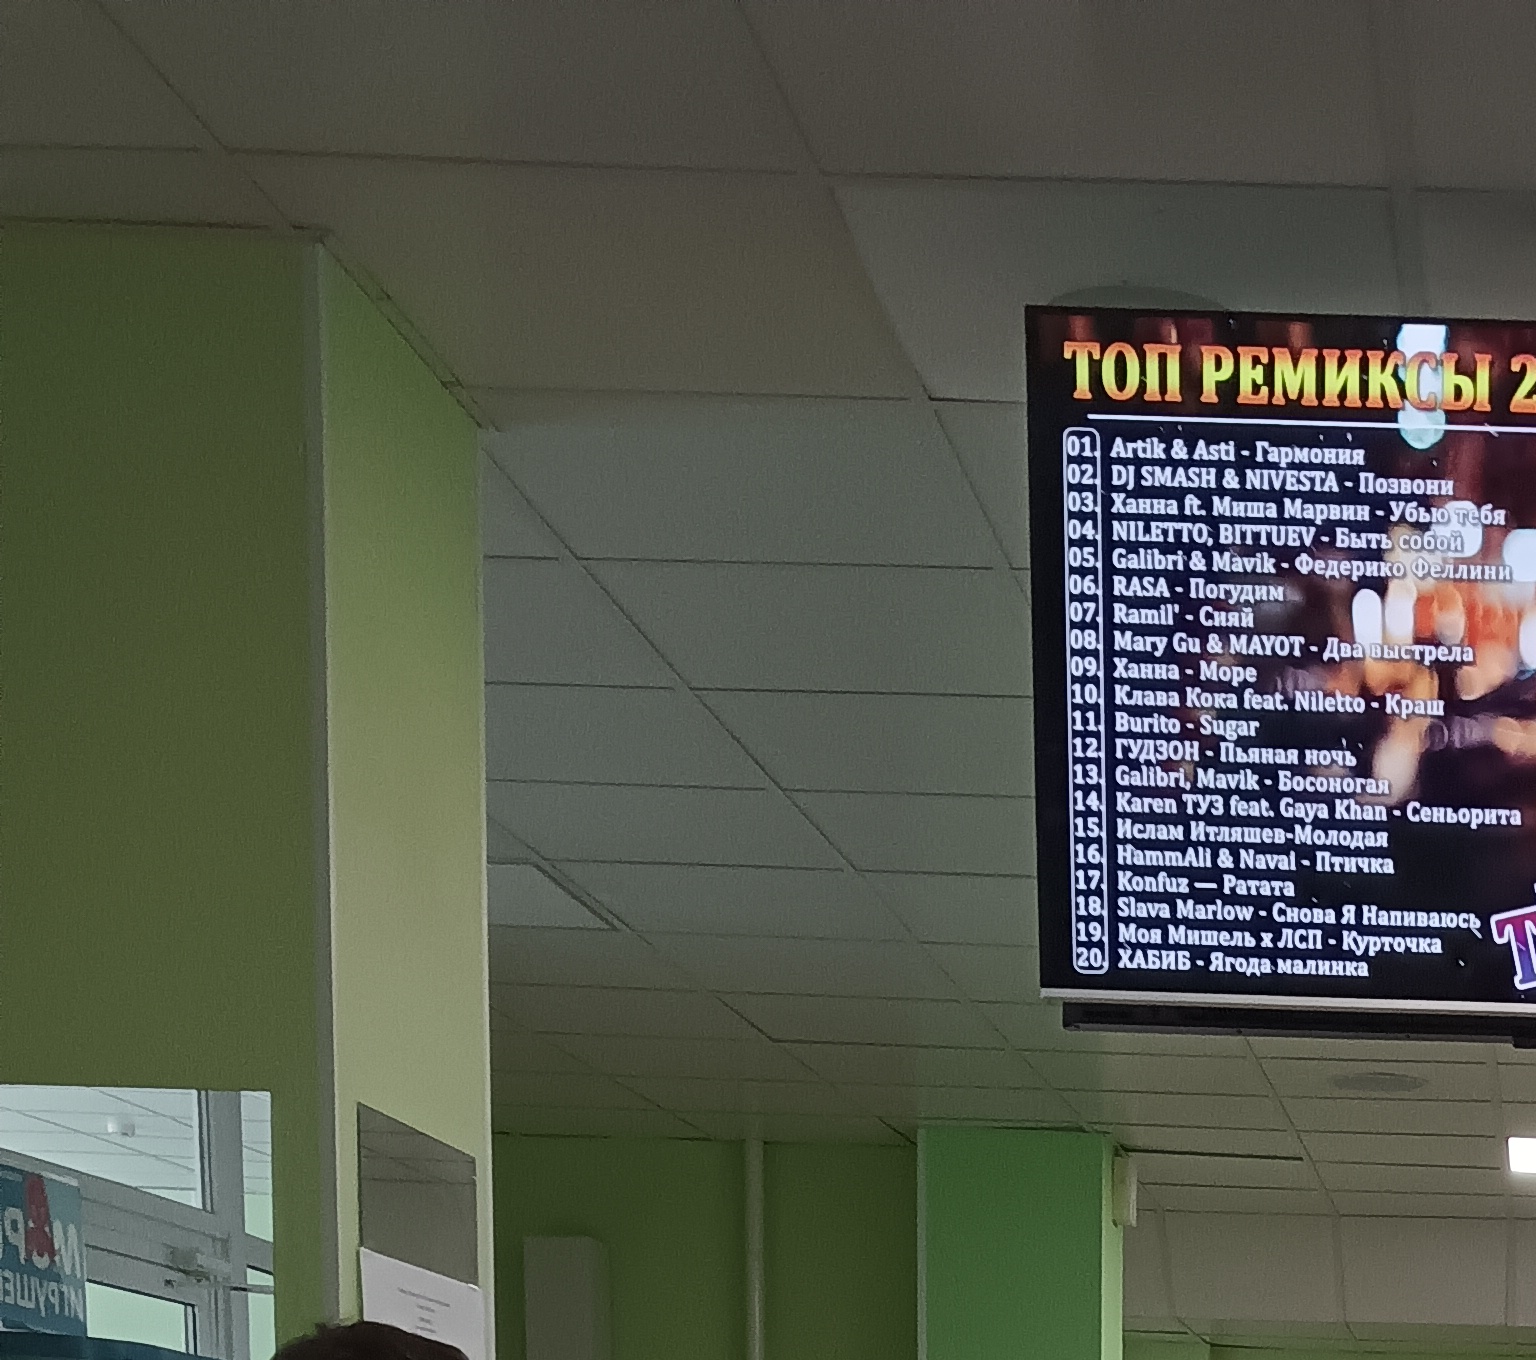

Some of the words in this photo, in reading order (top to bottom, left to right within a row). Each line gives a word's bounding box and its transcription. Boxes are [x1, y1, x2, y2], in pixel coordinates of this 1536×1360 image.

[1063, 341, 1182, 401] ТОП
[1200, 345, 1492, 412] РЕМИКСЫ
[1110, 436, 1167, 459] Artik
[1171, 438, 1190, 460] &
[1193, 439, 1236, 461] Asti
[1256, 441, 1366, 468] Гармония
[1112, 464, 1136, 488] DJ
[1140, 465, 1217, 489] SMASH
[1222, 468, 1241, 489] &
[1245, 469, 1339, 493] NIVESTA
[1358, 472, 1454, 496] Позвони
[1111, 492, 1178, 515] Ханна
[1182, 494, 1208, 516] ft.
[1211, 495, 1278, 519] Миша
[1283, 498, 1371, 525] Марвин
[1388, 501, 1448, 524] Убью
[1450, 503, 1506, 526] тебя
[1113, 520, 1214, 545] NILETTO,
[1218, 524, 1316, 547] BITTUEV
[1335, 527, 1394, 549] Быть
[1398, 529, 1464, 552] собой
[1112, 547, 1185, 571] Galibri
[1188, 550, 1207, 571] &
[1211, 550, 1276, 573] Mavik
[1294, 553, 1405, 581] Федерико
[1411, 557, 1513, 581] Феллини
[1113, 575, 1169, 598] RASA
[1189, 578, 1285, 605] Погудим
[1199, 605, 1255, 628] Сияй
[1113, 630, 1167, 655] Mary
[1172, 632, 1201, 653] Gu
[1206, 633, 1225, 654] &
[1229, 634, 1305, 656] MAYOT
[1323, 637, 1366, 660] Два
[1370, 644, 1474, 665] выстрела
[1113, 657, 1180, 680] Ханна
[1199, 660, 1258, 686] Море
[1114, 684, 1179, 707] Клава
[1184, 687, 1238, 709] Кока
[1242, 688, 1289, 711] feat.
[1294, 690, 1366, 713] Niletto
[1385, 693, 1445, 719] Краш
[1114, 711, 1179, 734] Burito
[1199, 714, 1260, 740] Sugar
[1115, 738, 1200, 764] ГУДЗОН
[1219, 742, 1299, 765] Пьяная
[1304, 749, 1357, 767] ночь
[1115, 764, 1192, 790] Galibri,
[1196, 767, 1259, 790] Mavik
[1278, 770, 1389, 794] Босоногая
[1116, 791, 1179, 814] Karen
[1183, 793, 1225, 816] ТУЗ
[1229, 795, 1276, 817] feat.
[1280, 797, 1330, 822] Gaya
[1334, 798, 1388, 821] Khan
[1406, 801, 1522, 828] Сеньорита
[1116, 817, 1185, 841] Ислам
[1216, 847, 1235, 868] &
[1315, 850, 1395, 873] Птичка
[1116, 869, 1190, 894] Konfuz
[1223, 873, 1295, 897] Ратата
[1117, 896, 1170, 918] Slava
[1177, 898, 1254, 921] Marlow
[1272, 901, 1336, 923] Снова
[1341, 904, 1357, 924] Я
[1361, 904, 1482, 928] Напиваюсь
[1118, 922, 1161, 944] Моя
[1170, 924, 1258, 947] Мишель
[1278, 928, 1323, 949] ЛСП
[1341, 930, 1443, 956] Курточка
[1117, 948, 1191, 971] ХАБИБ
[1209, 951, 1273, 975] Ягода
[1277, 959, 1369, 977] малинка
